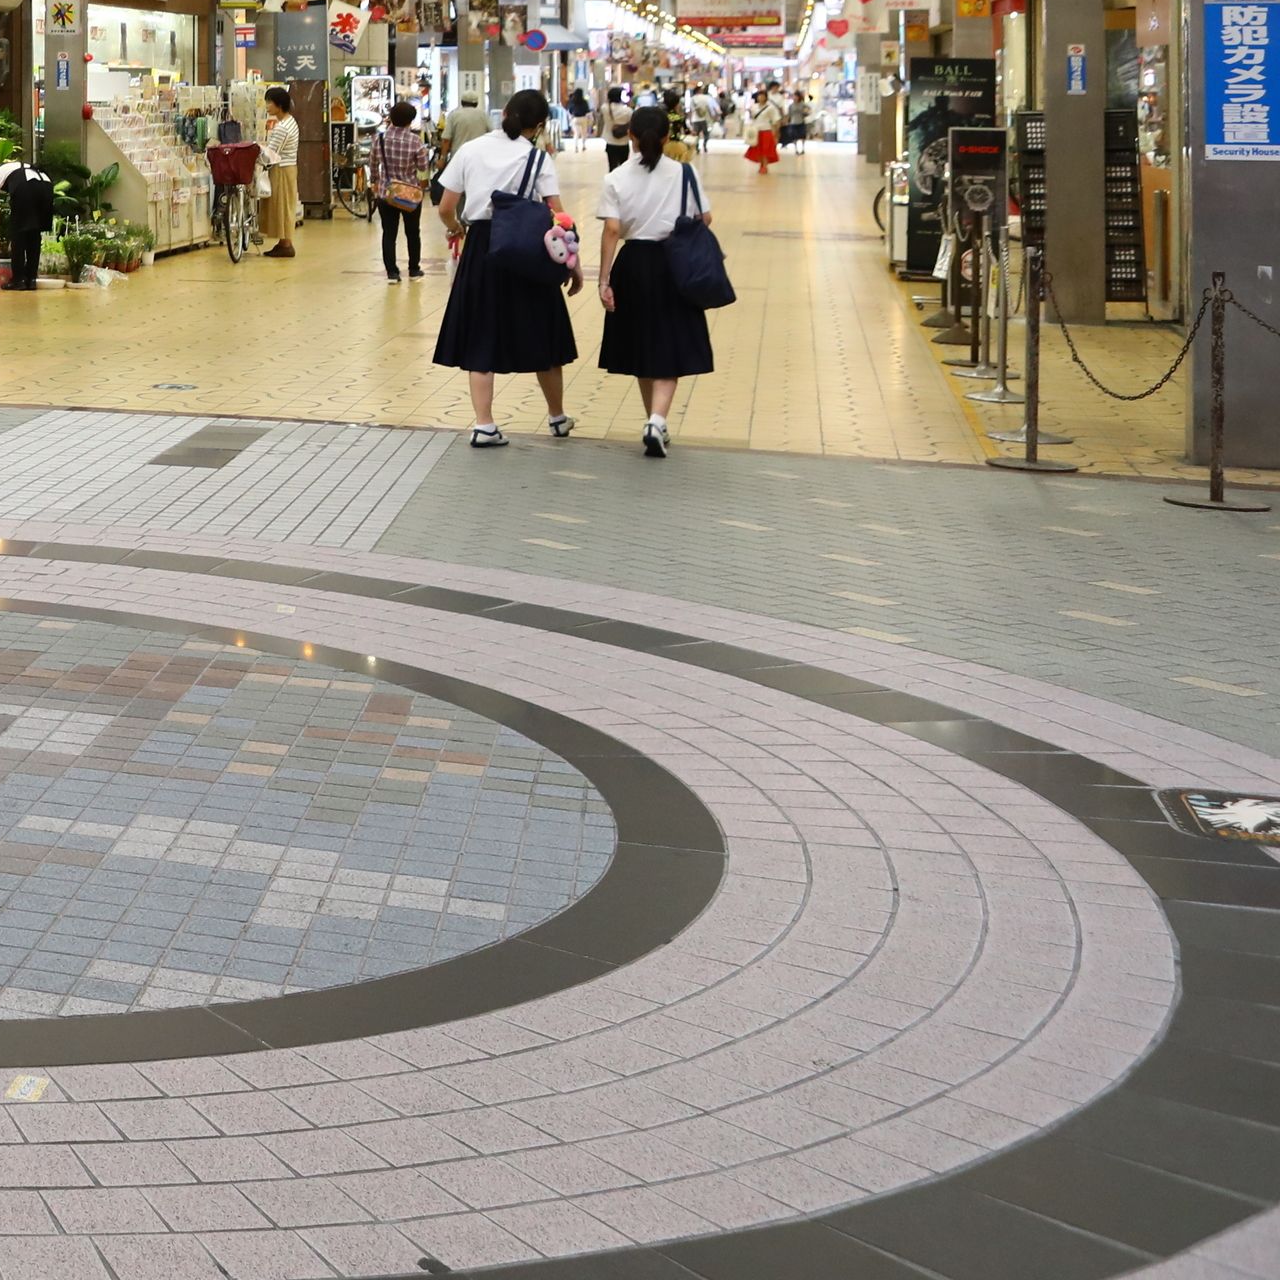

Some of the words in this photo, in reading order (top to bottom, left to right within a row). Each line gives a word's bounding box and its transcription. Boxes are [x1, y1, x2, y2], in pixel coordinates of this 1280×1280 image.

[934, 65, 973, 76] BALL
[1221, 6, 1270, 143] 防犯カメラ設置
[1212, 147, 1251, 157] Security
[1251, 147, 1280, 156] House
